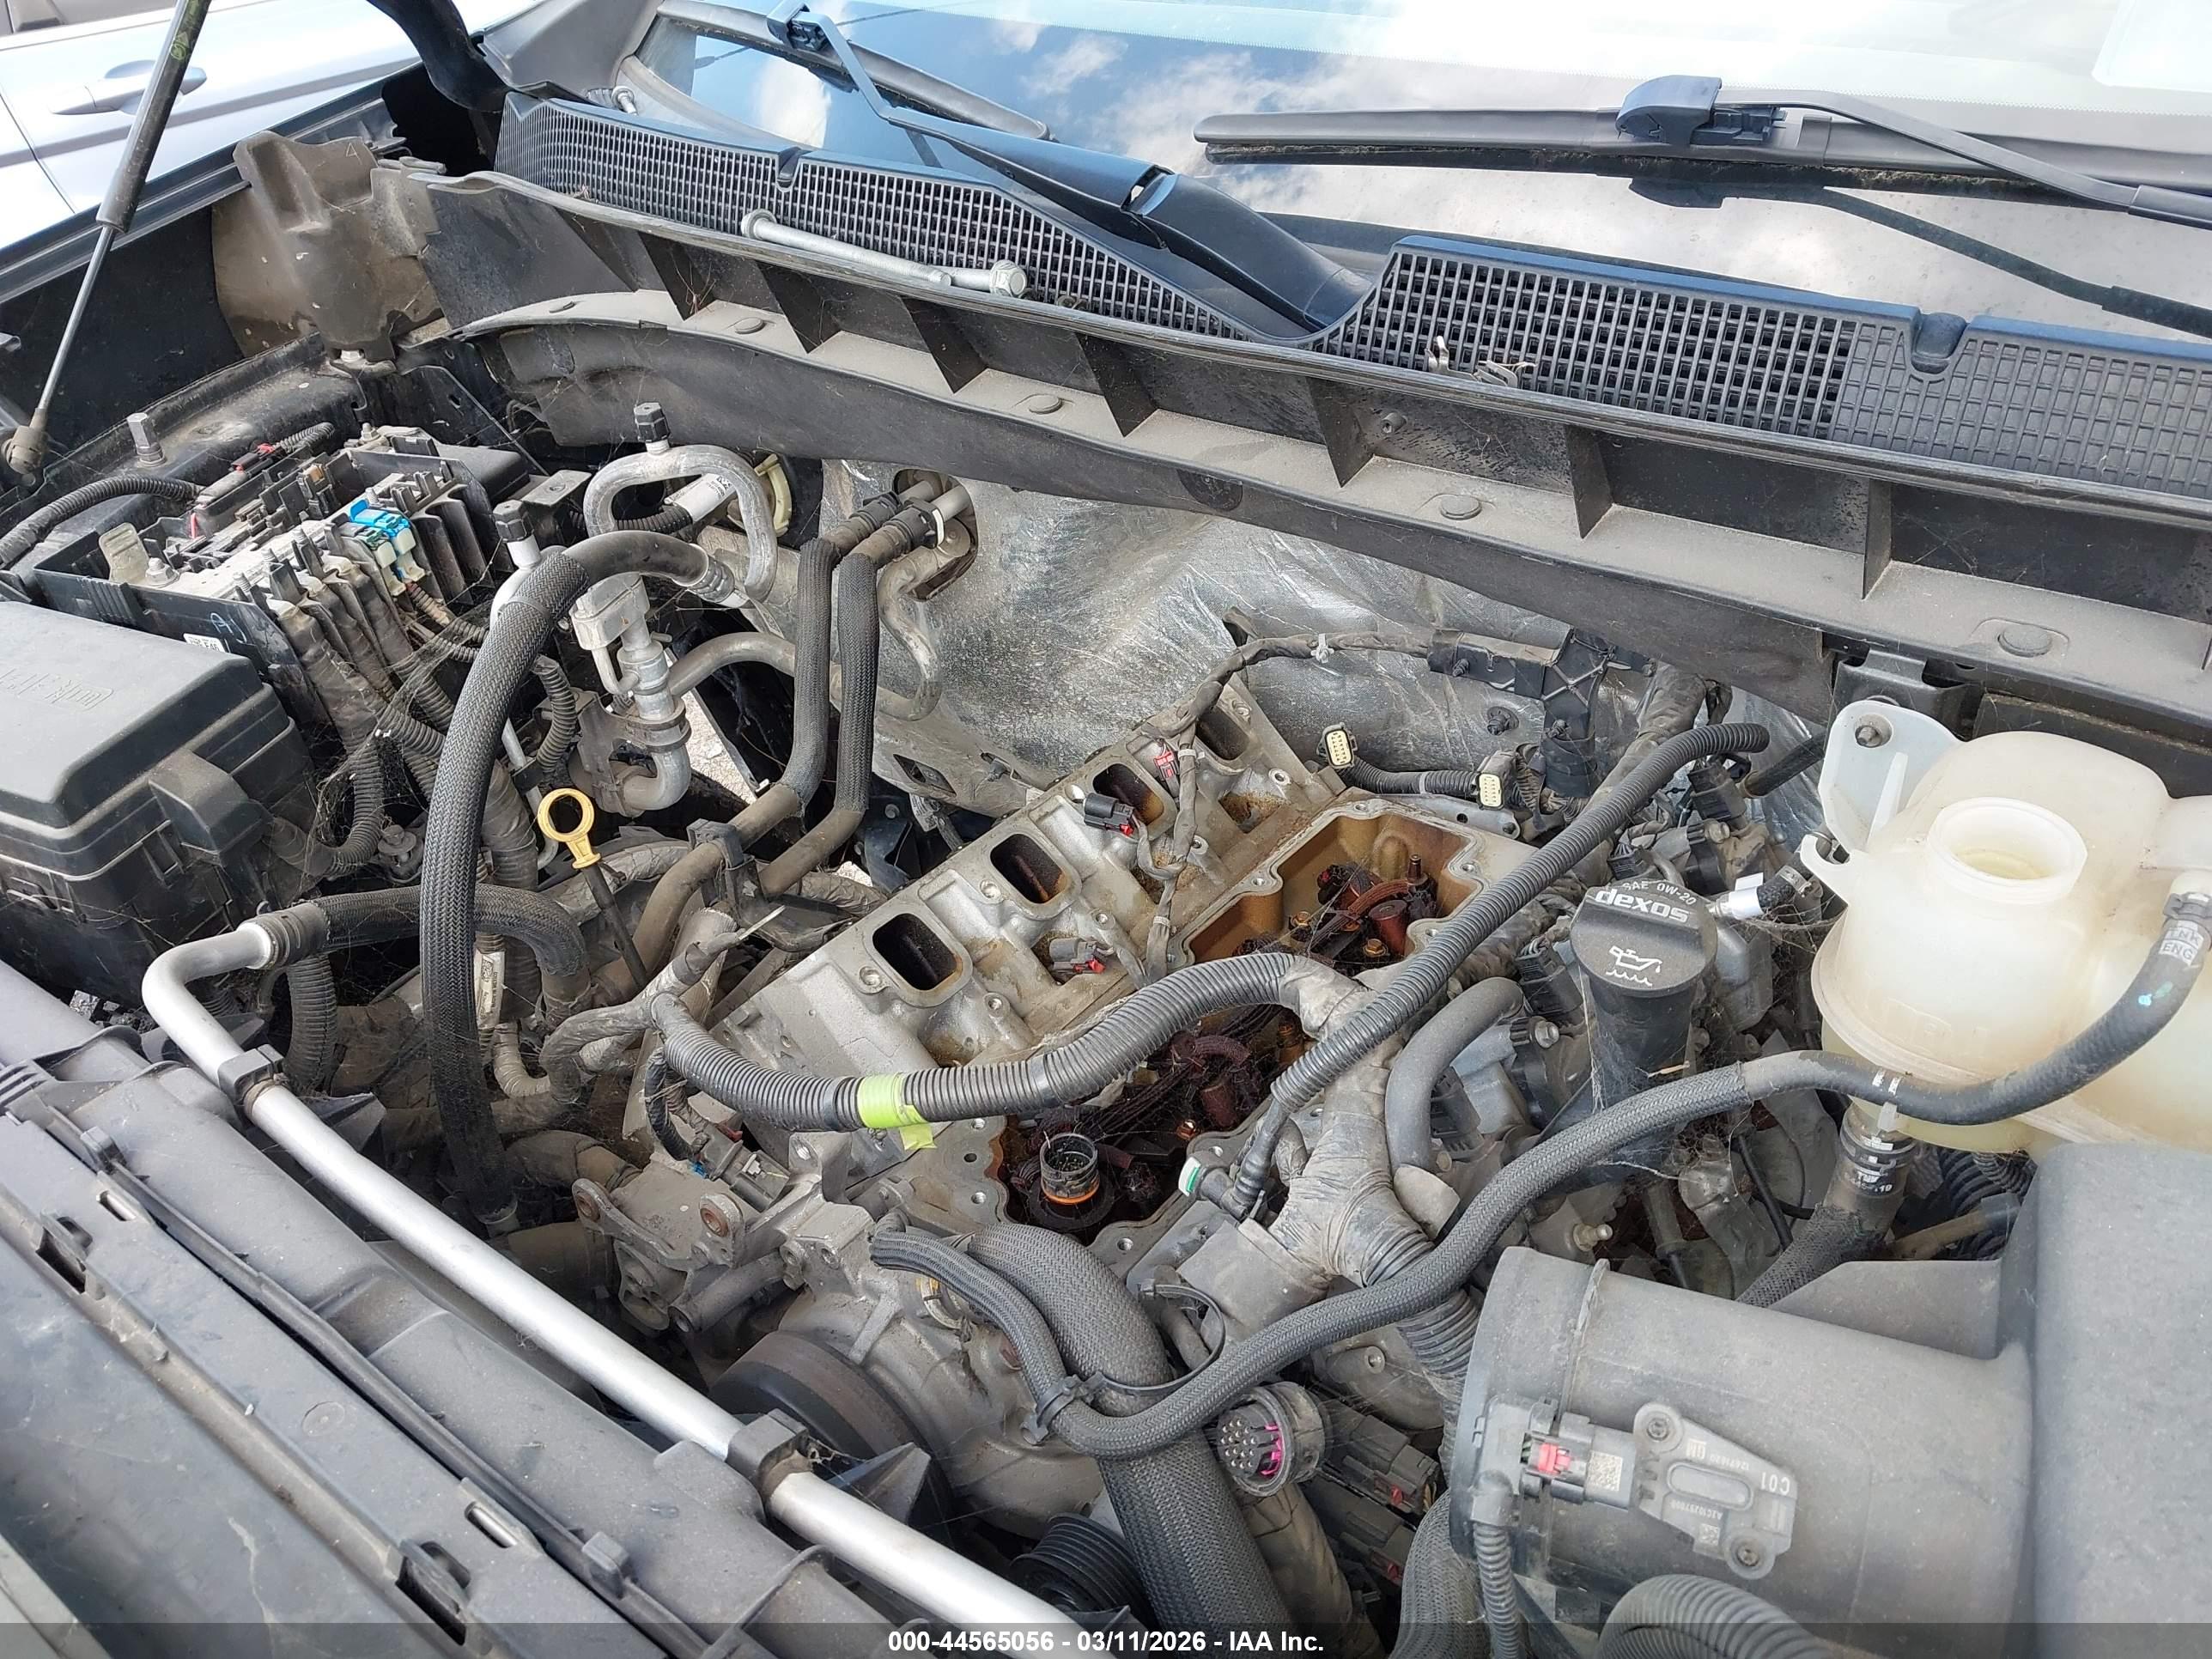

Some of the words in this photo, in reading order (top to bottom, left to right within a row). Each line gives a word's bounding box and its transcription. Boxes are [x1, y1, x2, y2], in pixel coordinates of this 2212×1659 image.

[1595, 887, 1692, 923] dexos
[1622, 880, 1649, 891] SAE
[1656, 882, 1698, 905] 0W-20
[2163, 942, 2193, 961] ENG
[1760, 1471, 1791, 1496] C01
